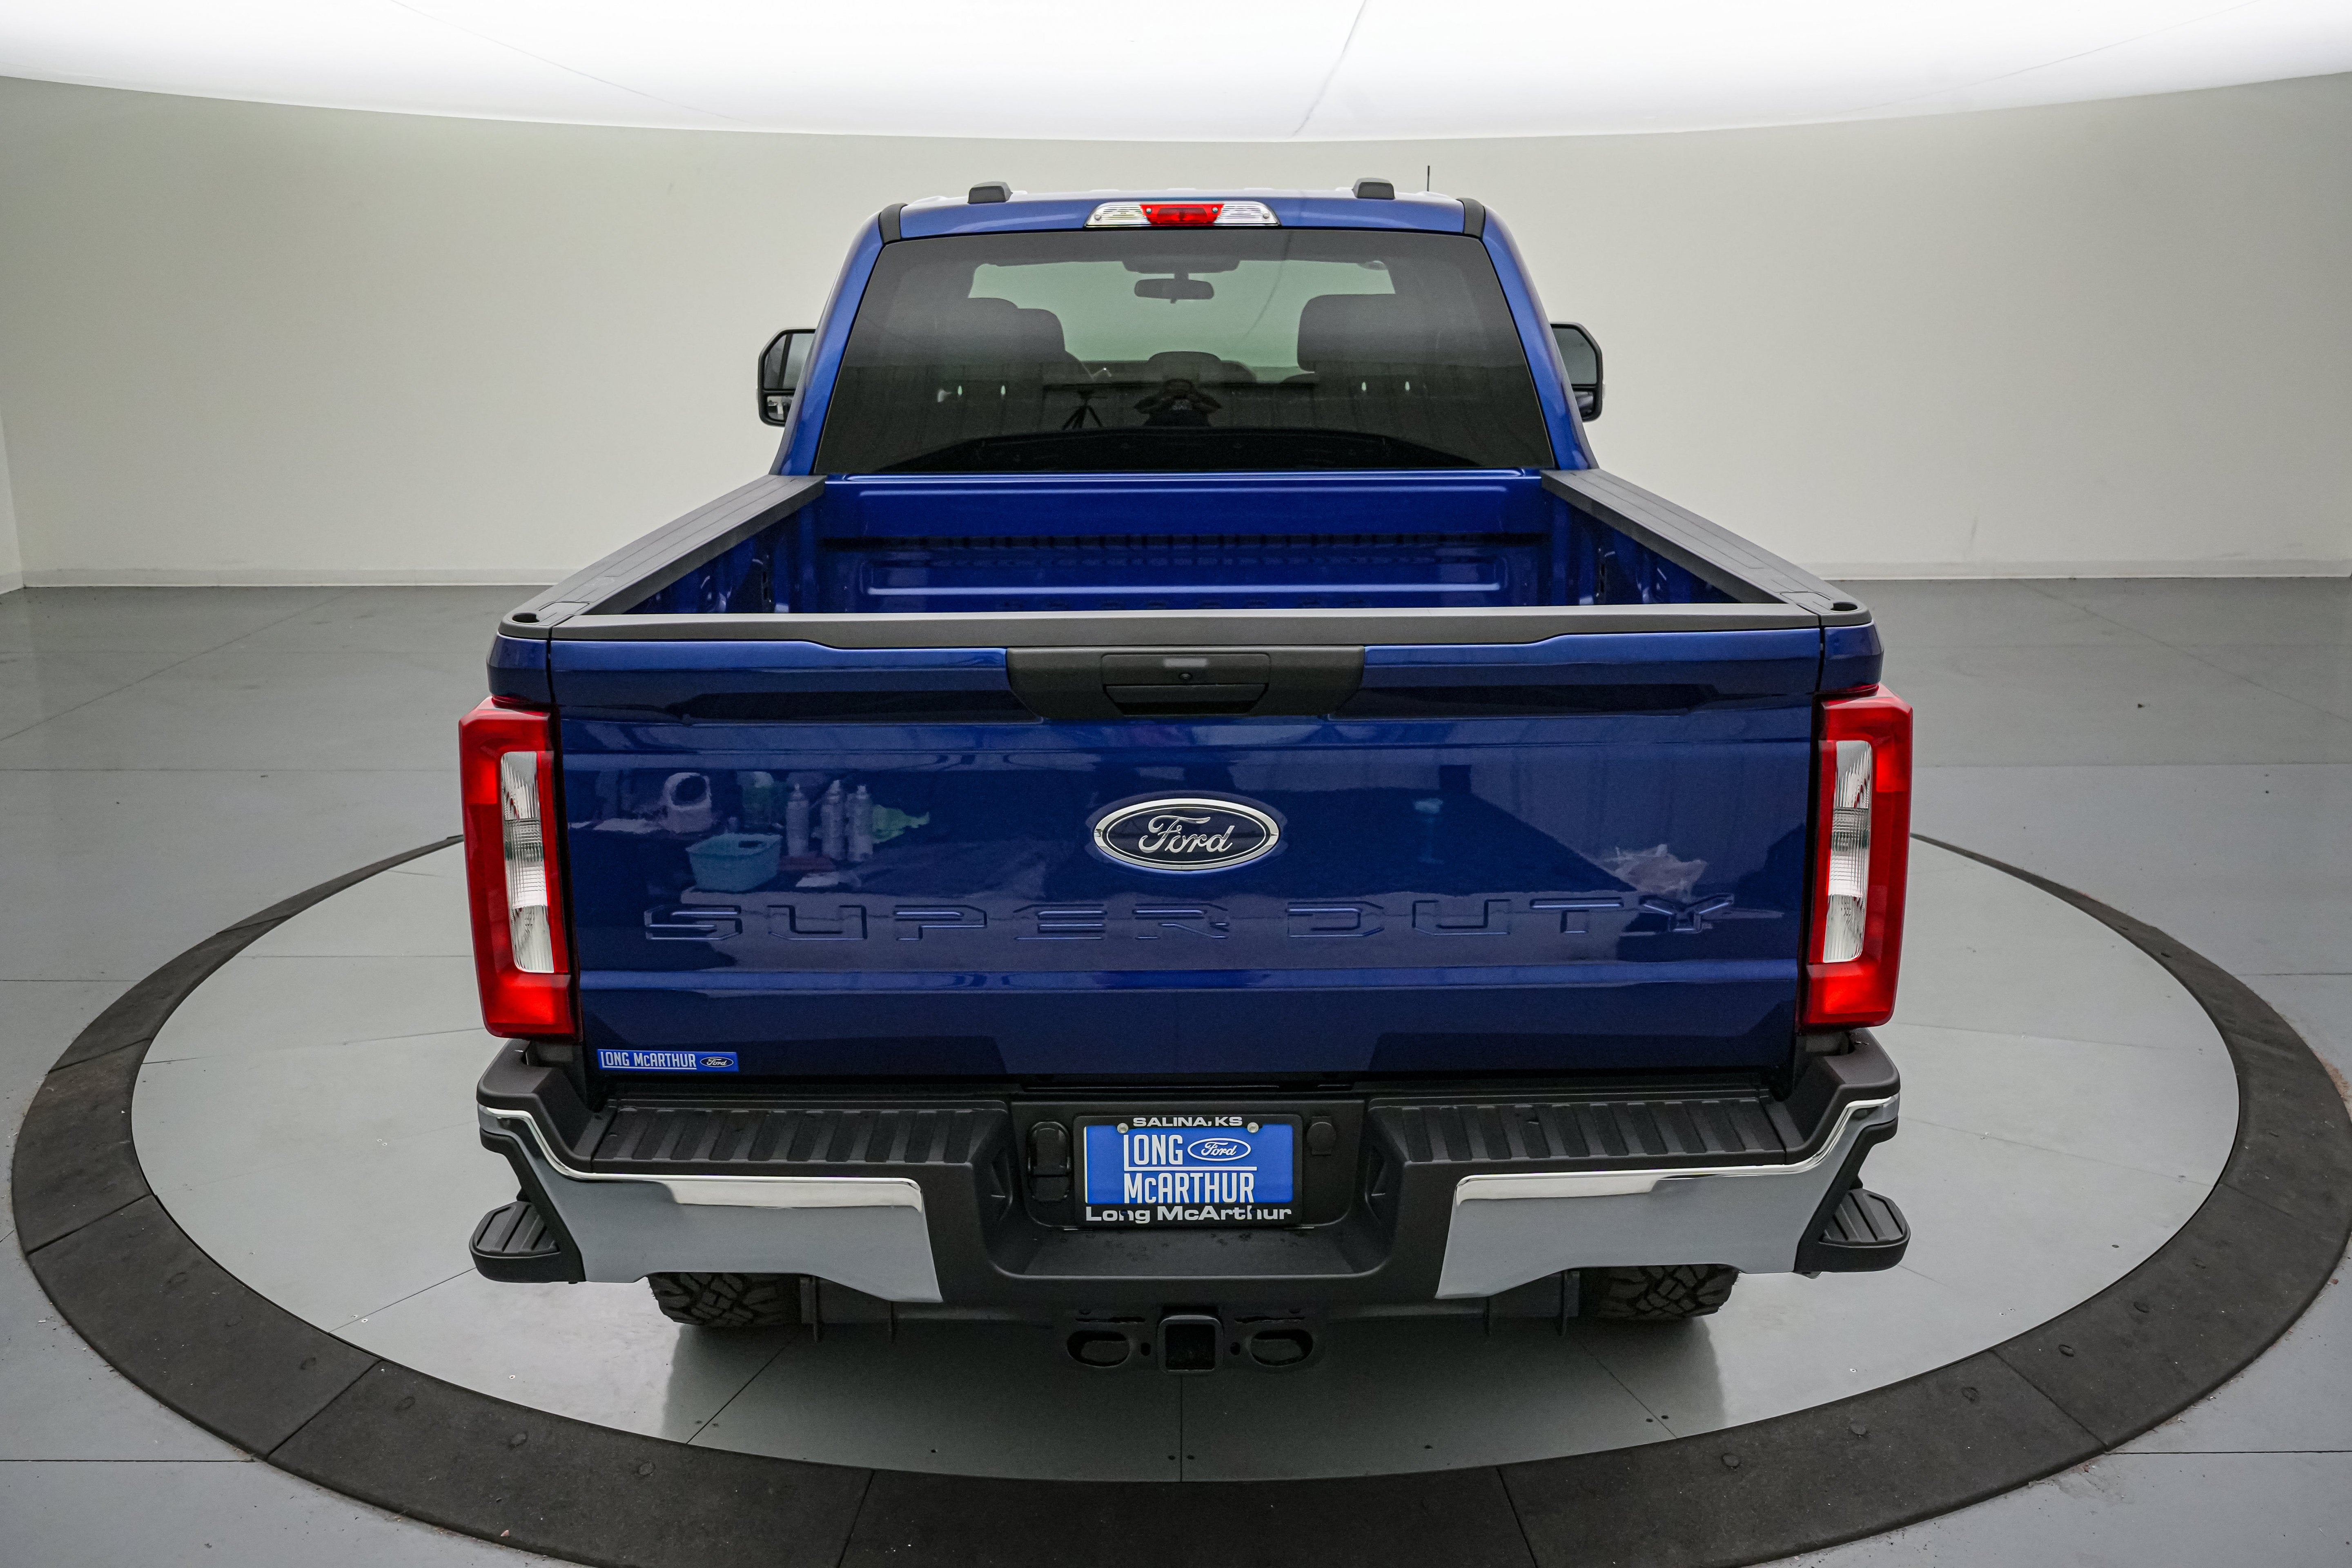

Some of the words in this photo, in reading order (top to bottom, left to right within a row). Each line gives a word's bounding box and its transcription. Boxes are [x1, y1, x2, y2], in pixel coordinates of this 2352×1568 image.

[1138, 815, 1235, 853] Ford
[644, 903, 1229, 941] SUPER
[1285, 893, 1735, 939] DUTY
[601, 1051, 630, 1068] LONG
[633, 1052, 697, 1067] McARTHUR
[1133, 1117, 1212, 1127] SALINA,
[1215, 1117, 1243, 1126] KS
[1124, 1134, 1183, 1171] LONG
[1201, 1142, 1237, 1156] Ford
[1124, 1173, 1254, 1203] McARTHUR
[1086, 1206, 1150, 1224] Long
[1157, 1205, 1292, 1221] McArthur
